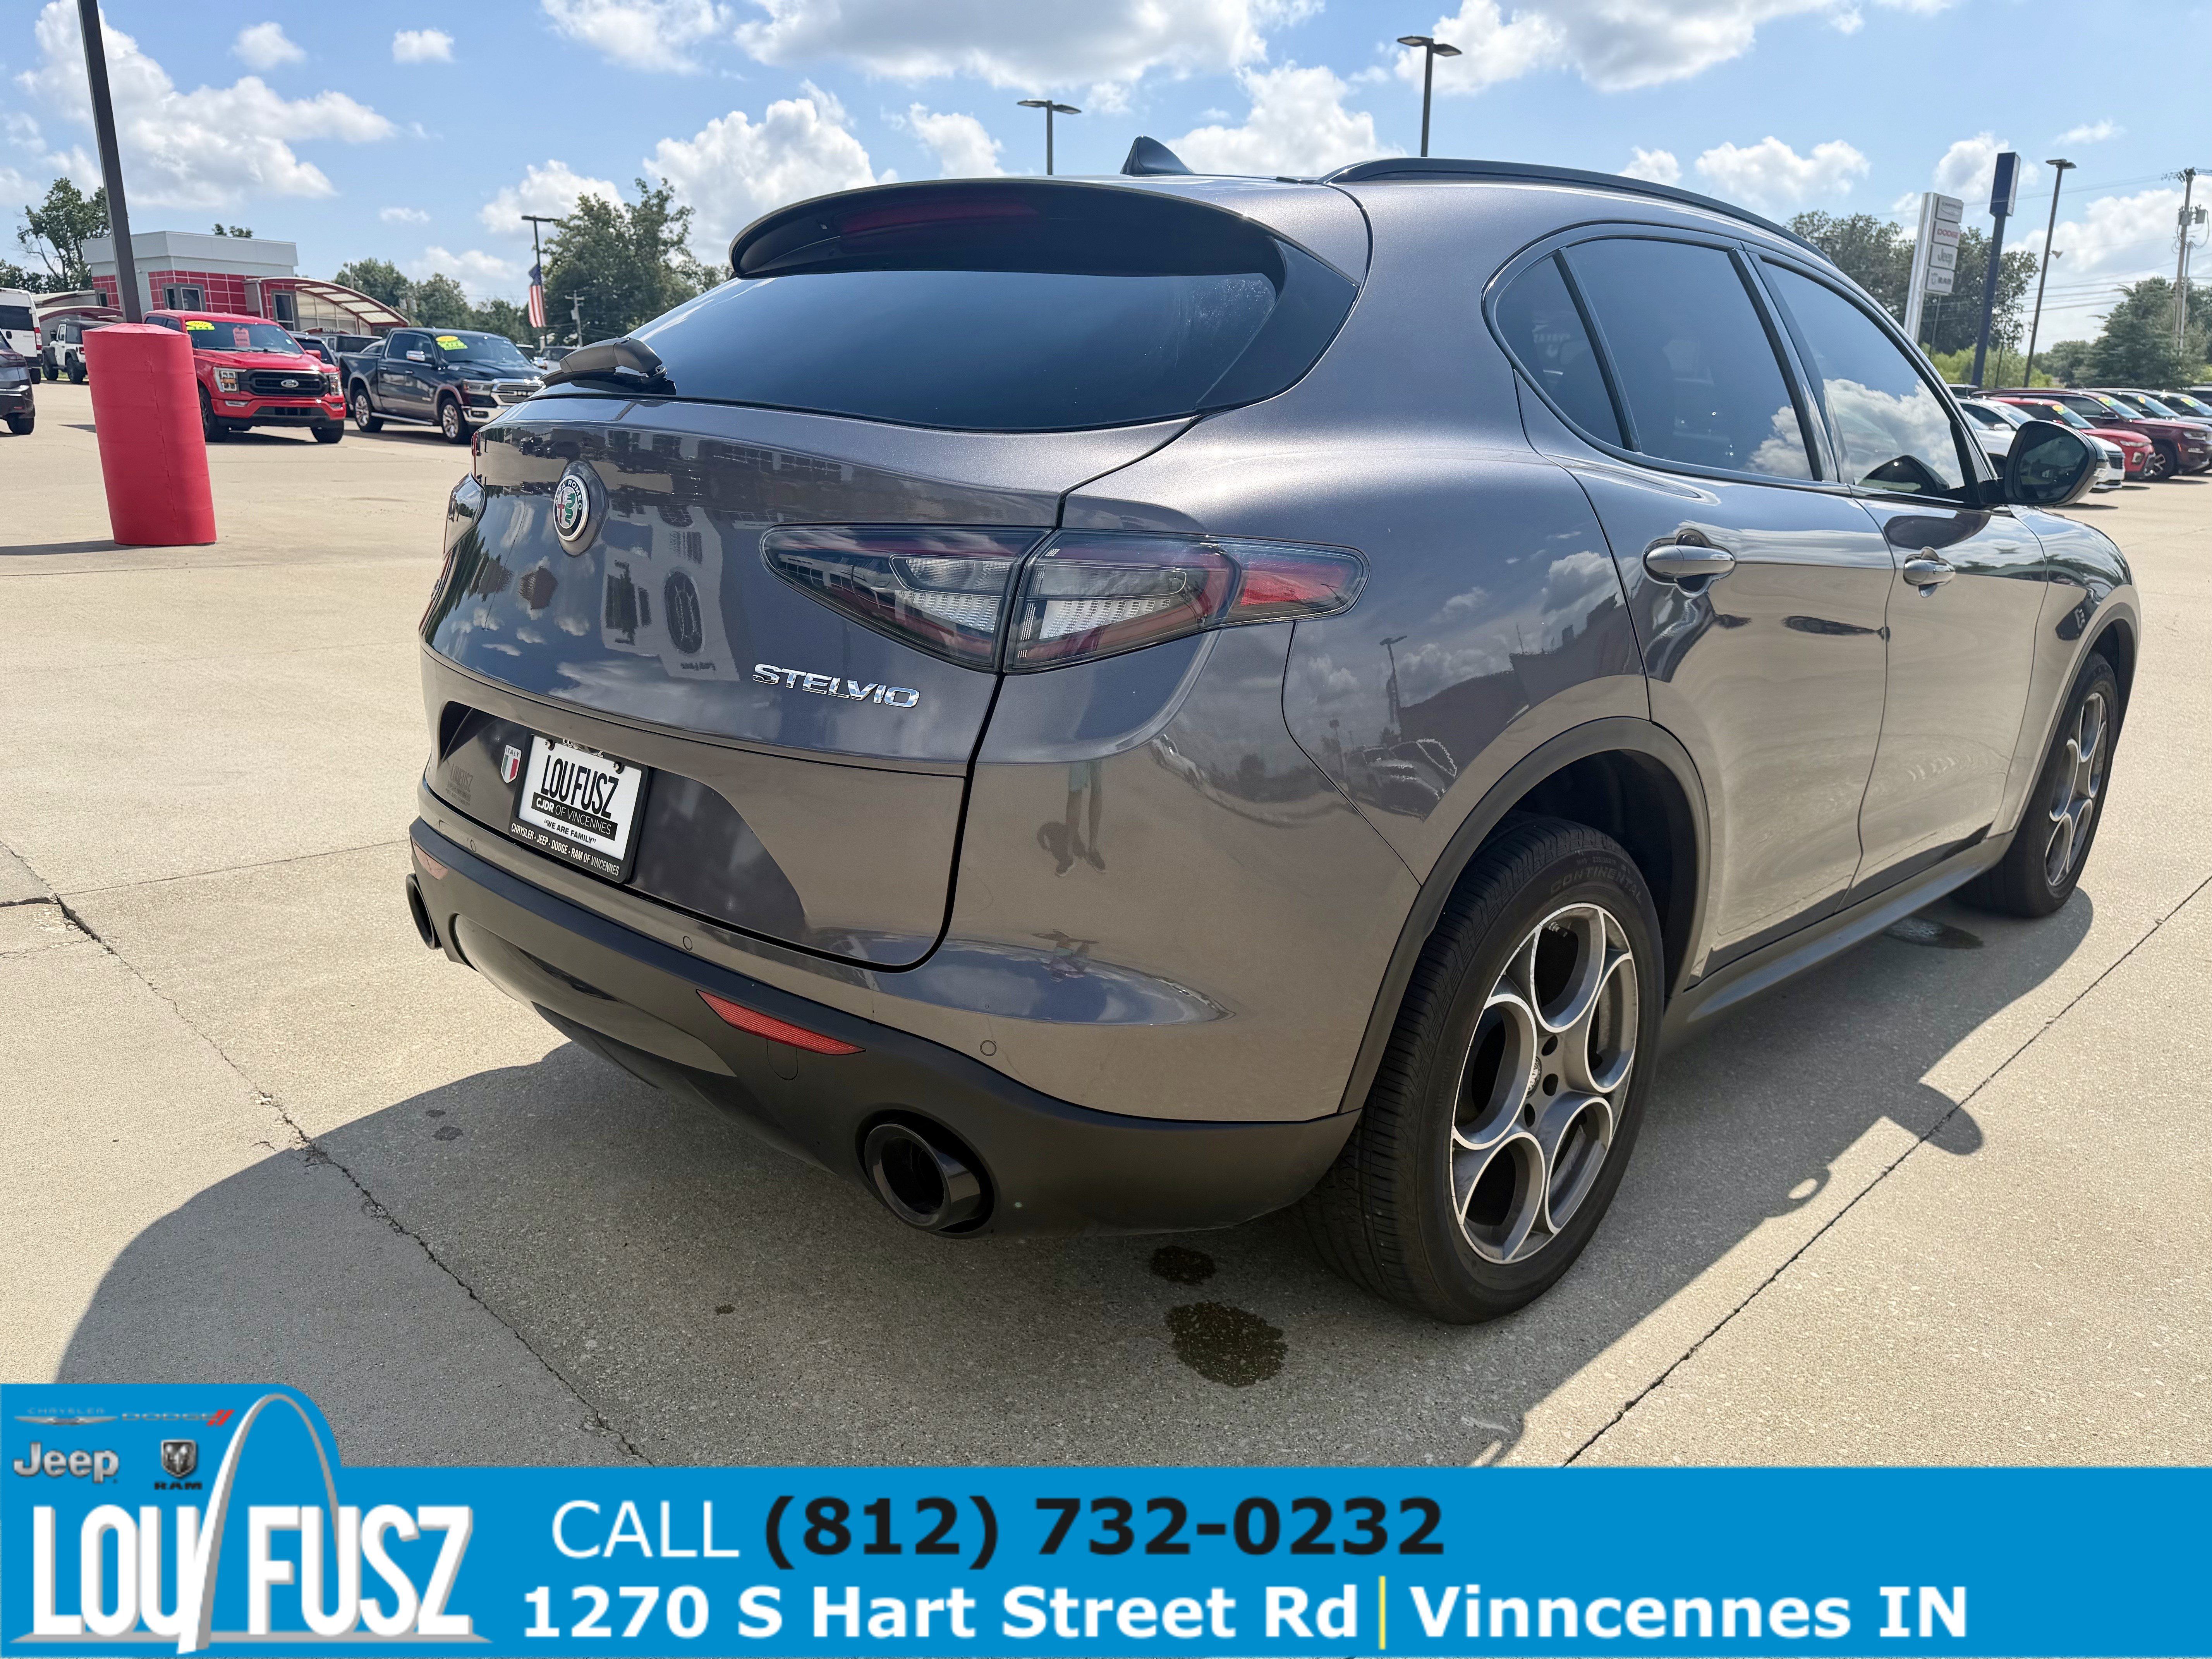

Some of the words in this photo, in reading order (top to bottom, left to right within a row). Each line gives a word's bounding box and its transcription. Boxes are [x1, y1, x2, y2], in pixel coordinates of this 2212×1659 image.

[568, 480, 582, 510] ROMEO
[752, 663, 920, 708] STELVIO
[505, 747, 520, 757] ITALY
[541, 755, 575, 802] LOU
[570, 765, 619, 819] FUSZ
[536, 797, 554, 813] CJDR
[555, 805, 567, 816] OF
[568, 809, 611, 835] VINCENNES
[556, 825, 569, 835] ARE
[511, 823, 534, 839] CHRYSLER
[536, 833, 548, 846] JEEP
[551, 840, 568, 854] DODGE
[572, 847, 583, 861] RAM
[584, 853, 591, 863] OF
[591, 855, 619, 876] VINCENNES
[1551, 866, 1642, 905] CONTINENTAL
